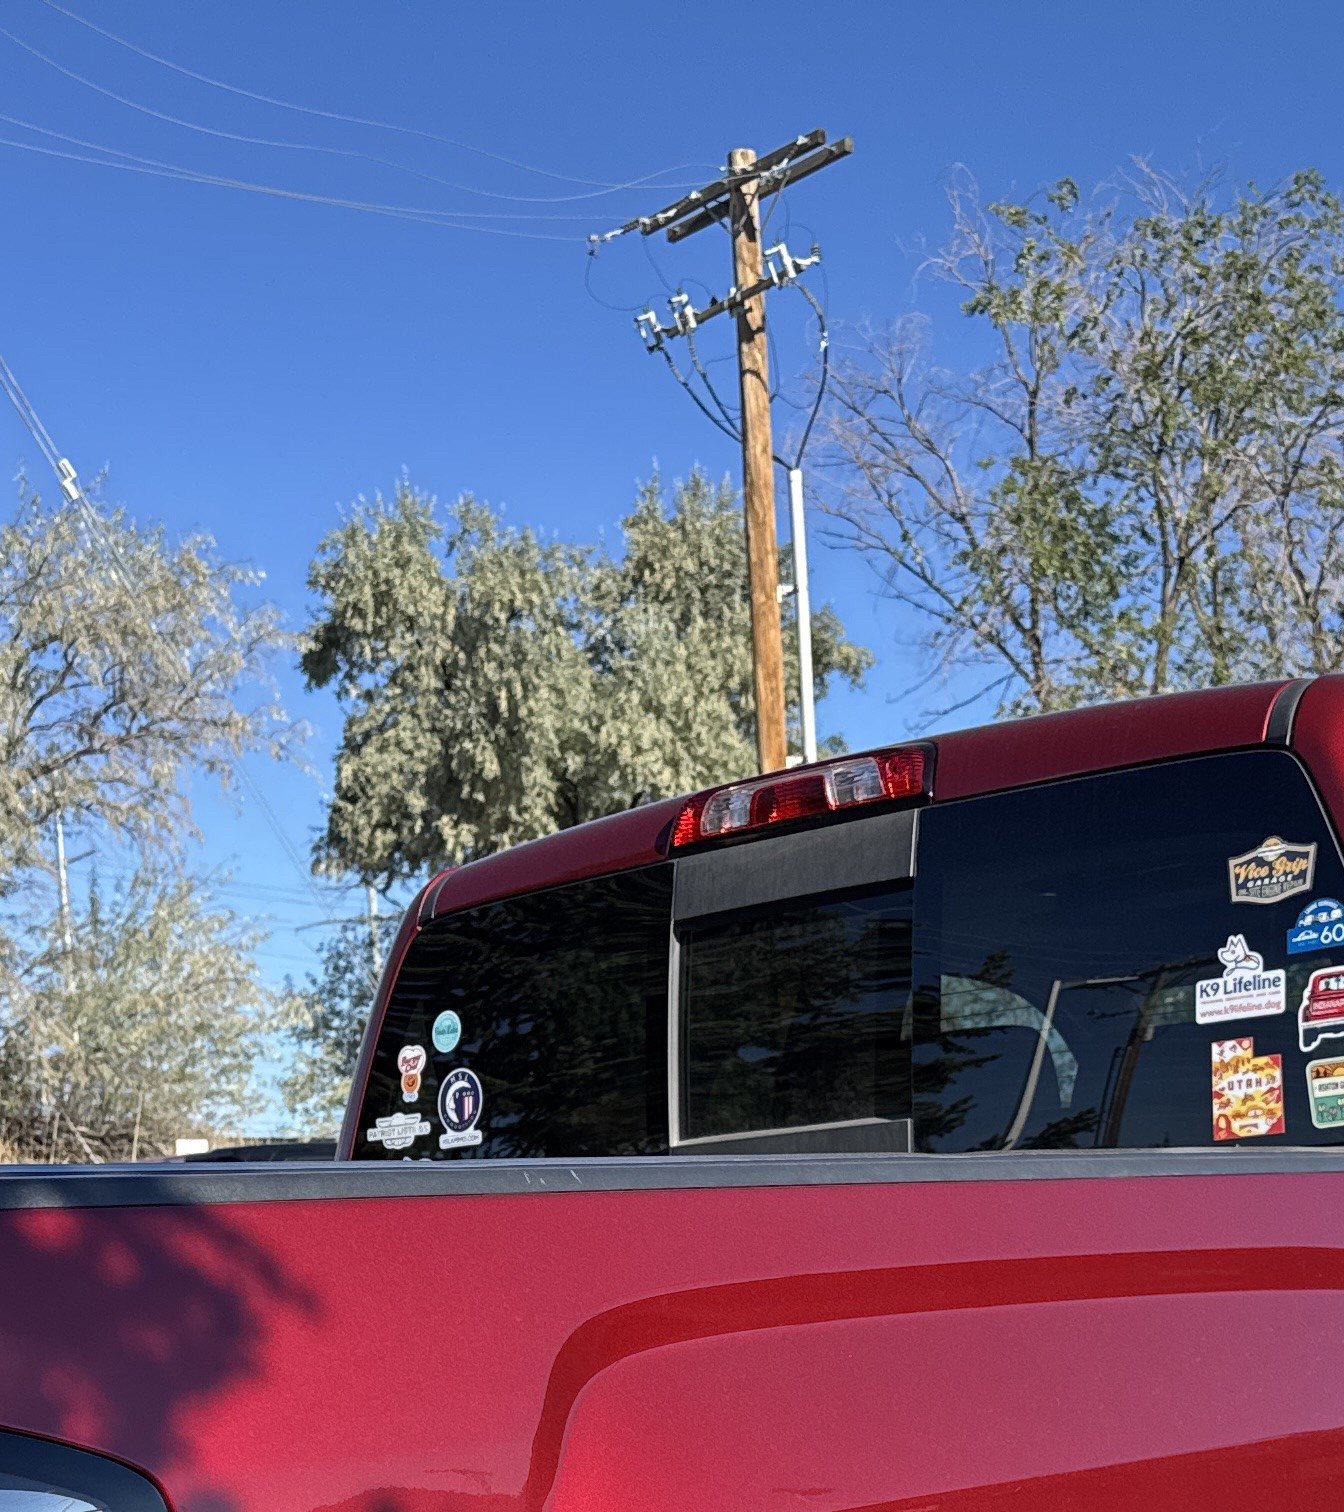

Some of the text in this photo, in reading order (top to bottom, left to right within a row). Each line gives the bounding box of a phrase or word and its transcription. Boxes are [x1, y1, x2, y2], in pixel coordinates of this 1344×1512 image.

[1199, 982, 1220, 998] K9
[1223, 974, 1281, 995] Lifeline
[1227, 1078, 1262, 1091] UTAH
